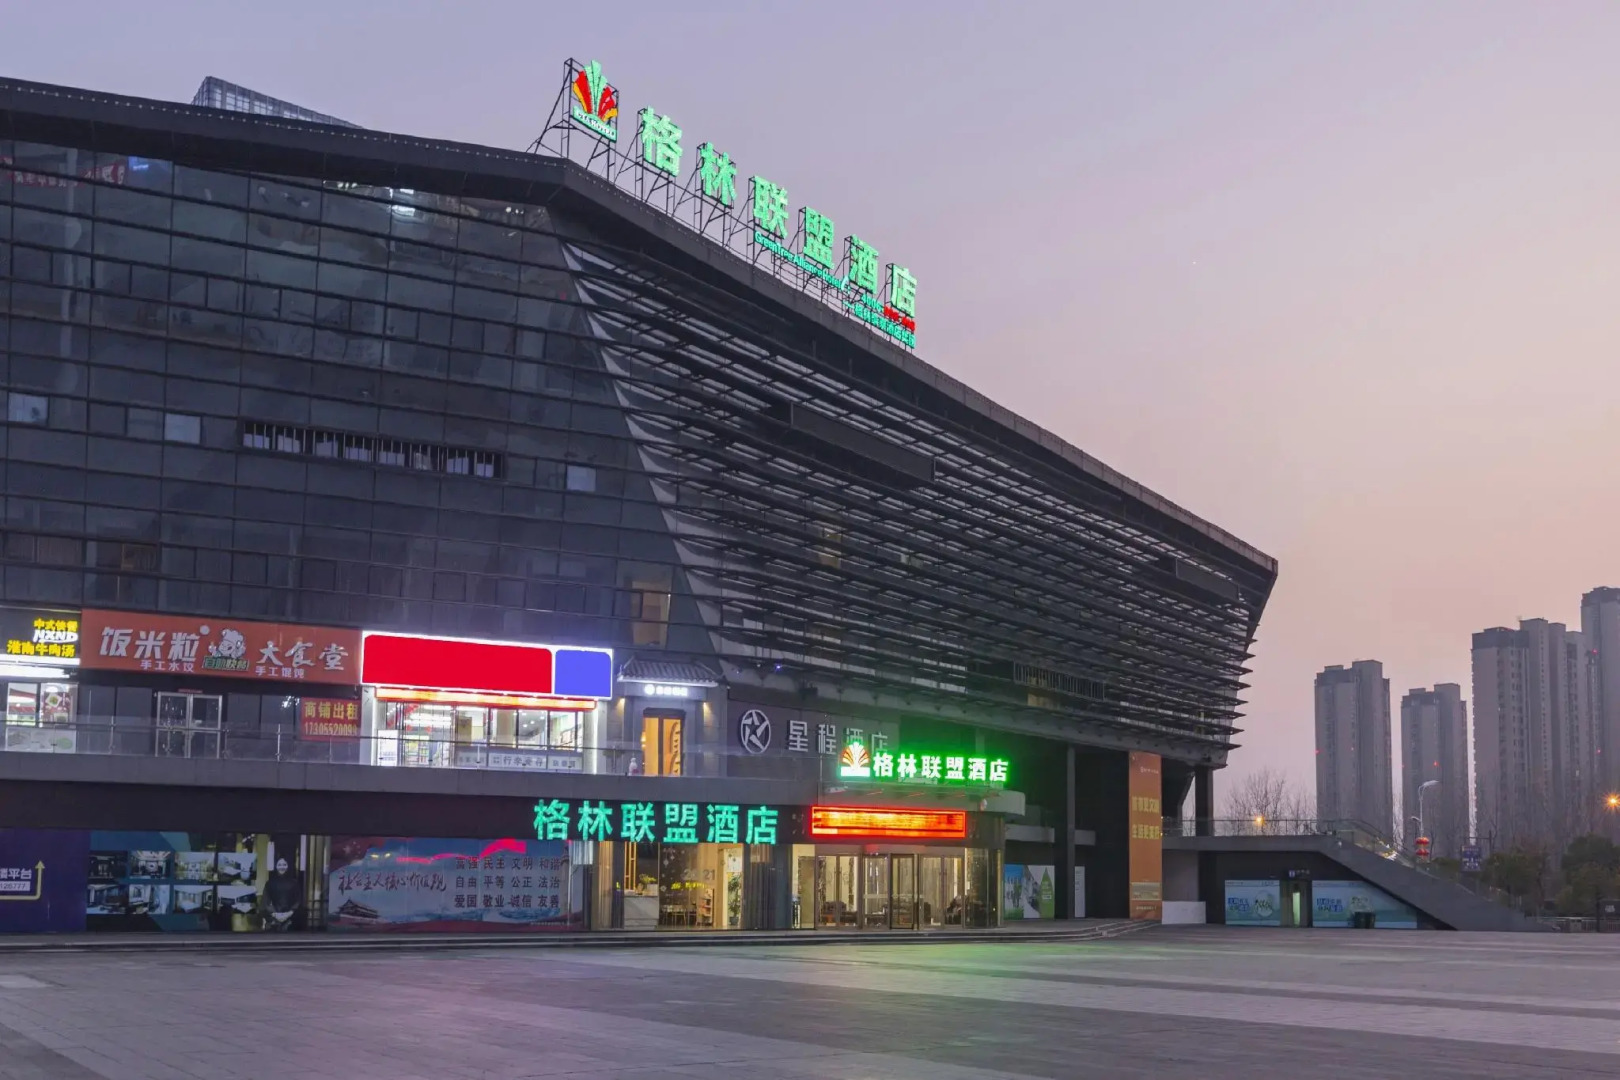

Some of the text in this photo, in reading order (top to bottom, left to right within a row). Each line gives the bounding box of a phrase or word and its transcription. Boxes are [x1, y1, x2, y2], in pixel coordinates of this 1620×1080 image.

[641, 106, 918, 318] 格林联盟酒店
[99, 626, 349, 671] 饭米粒 大食堂
[140, 659, 195, 673] 手工水饺
[255, 665, 305, 679] 手工馄饨
[305, 701, 359, 720] 商铺出租
[872, 752, 1010, 782] 格林联盟酒店
[533, 799, 779, 845] 格林联盟酒店
[455, 856, 560, 871] 富强 民主 文明 和谐
[455, 875, 560, 889] 自由 平等 公正 法治
[454, 894, 560, 908] 爱国 敬业 诚信 友善
